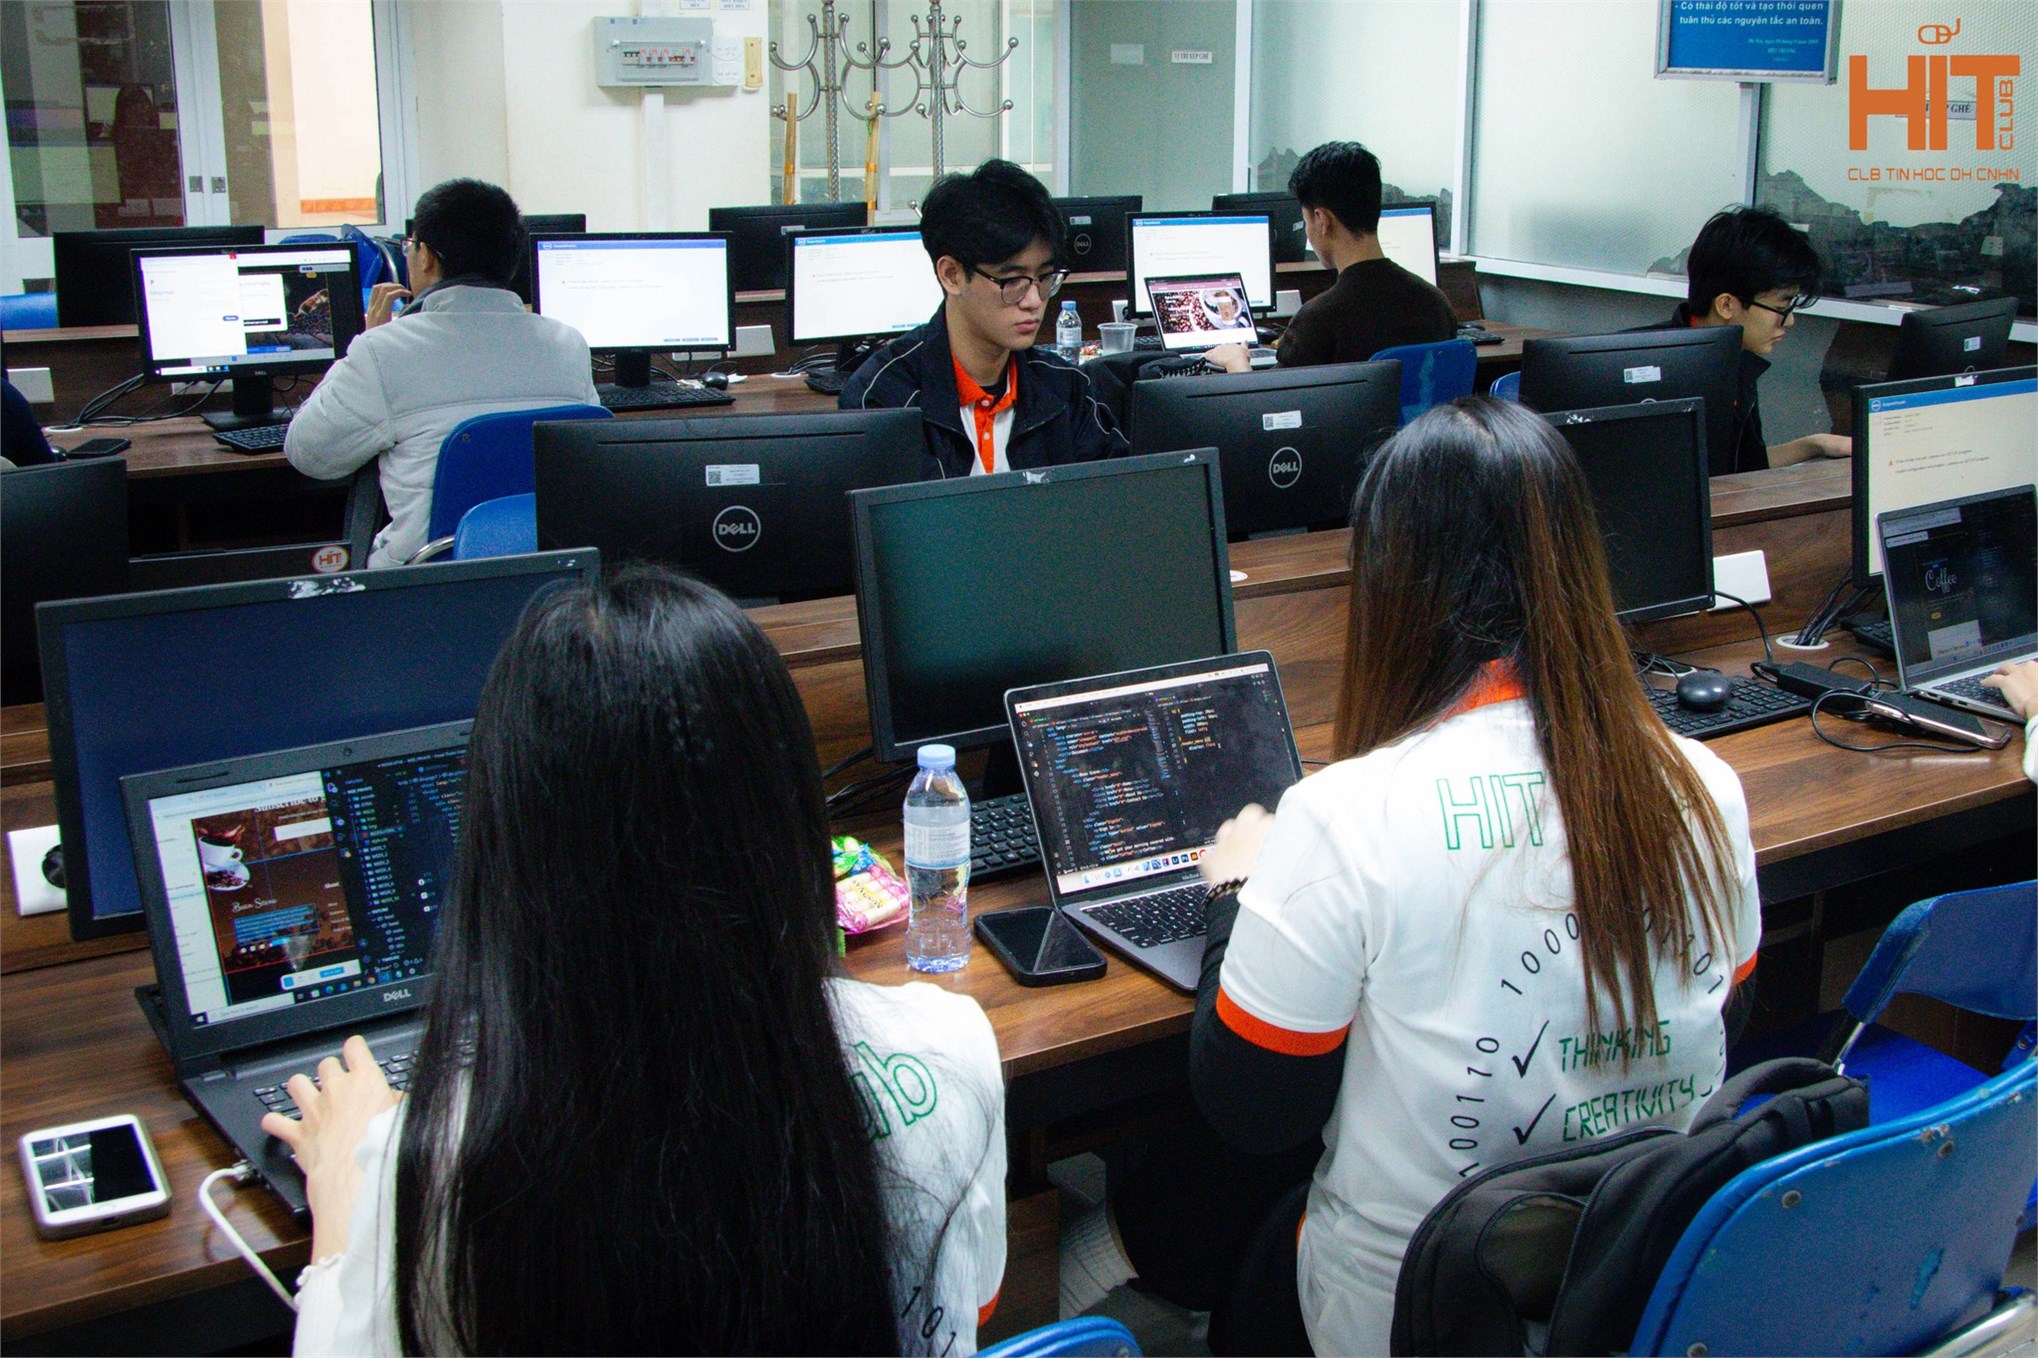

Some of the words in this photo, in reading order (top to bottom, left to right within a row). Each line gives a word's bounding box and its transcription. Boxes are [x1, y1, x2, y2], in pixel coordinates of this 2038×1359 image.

[1680, 2, 1694, 10] Có
[1696, 2, 1714, 10] thái
[1716, 2, 1728, 12] độ
[1745, 2, 1757, 10] và
[1759, 2, 1774, 12] tạo
[1799, 3, 1824, 12] quen
[1680, 16, 1699, 24] tuân
[1701, 14, 1715, 24] thủ
[1717, 16, 1732, 24] các
[1735, 16, 1767, 26] nguyên
[1770, 14, 1784, 24] tắc
[1273, 462, 1299, 474] DELL
[718, 522, 756, 535] DELL
[319, 552, 342, 565] HIT
[1924, 567, 1958, 593] Coffee
[1436, 772, 1545, 850] HIT
[232, 902, 253, 913] Bean
[384, 989, 411, 1002] DELL
[1562, 1074, 1695, 1142] CREATIVITY
